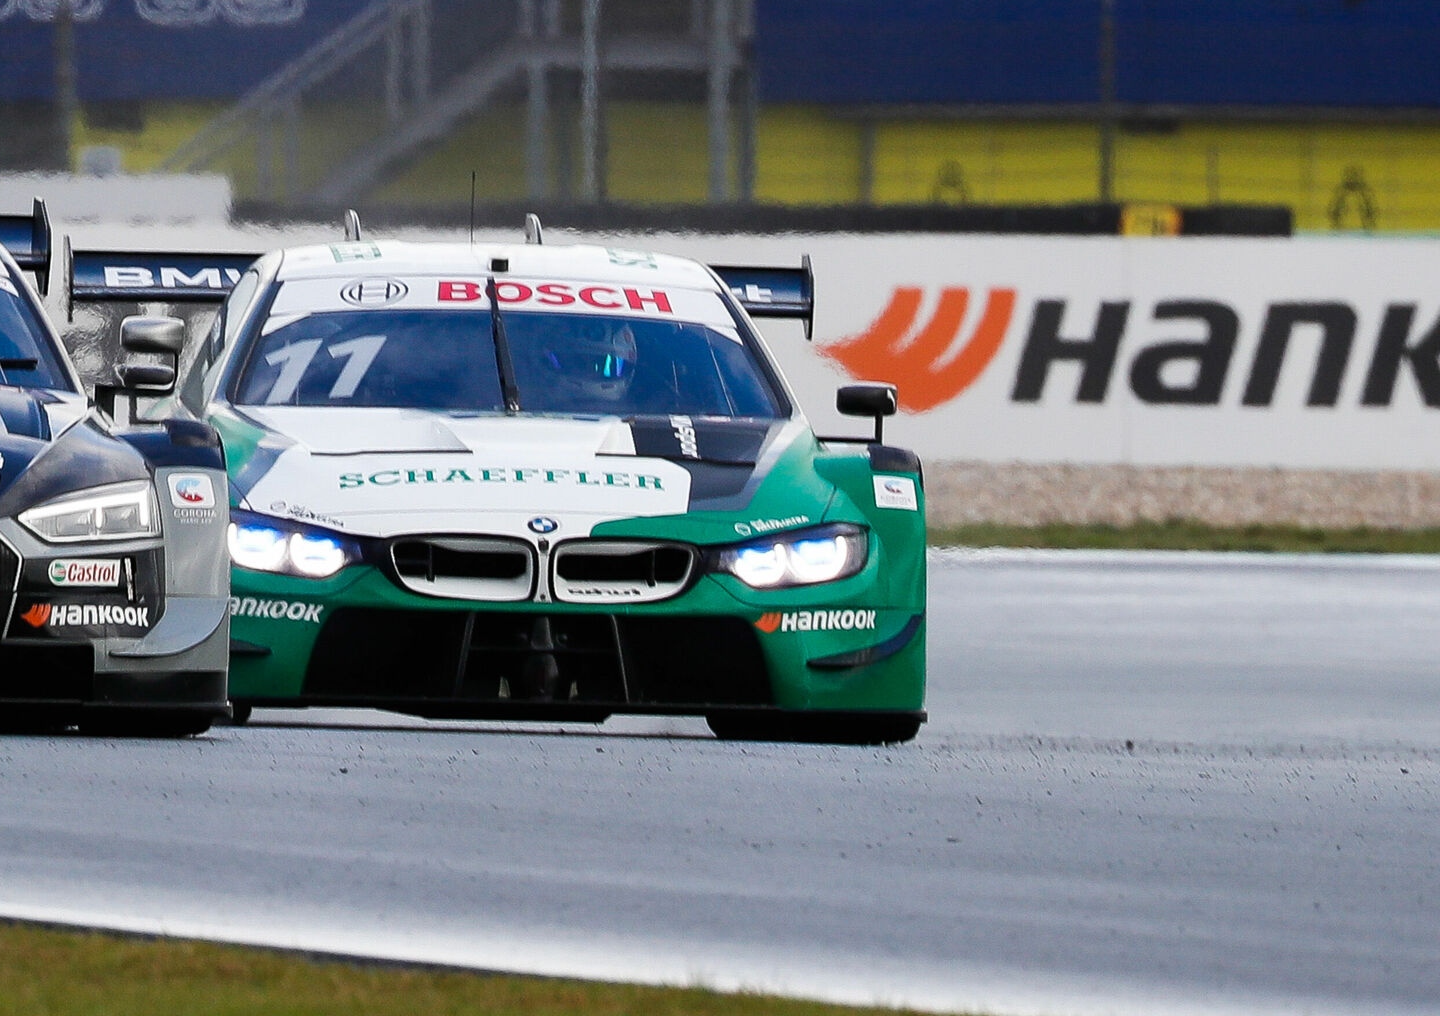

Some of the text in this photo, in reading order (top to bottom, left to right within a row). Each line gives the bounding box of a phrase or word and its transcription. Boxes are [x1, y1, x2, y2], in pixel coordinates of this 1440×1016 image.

[437, 280, 673, 313] BOSCH
[261, 335, 387, 404] 11
[339, 467, 665, 491] SCHAEFFLER
[67, 562, 116, 582] Castrol
